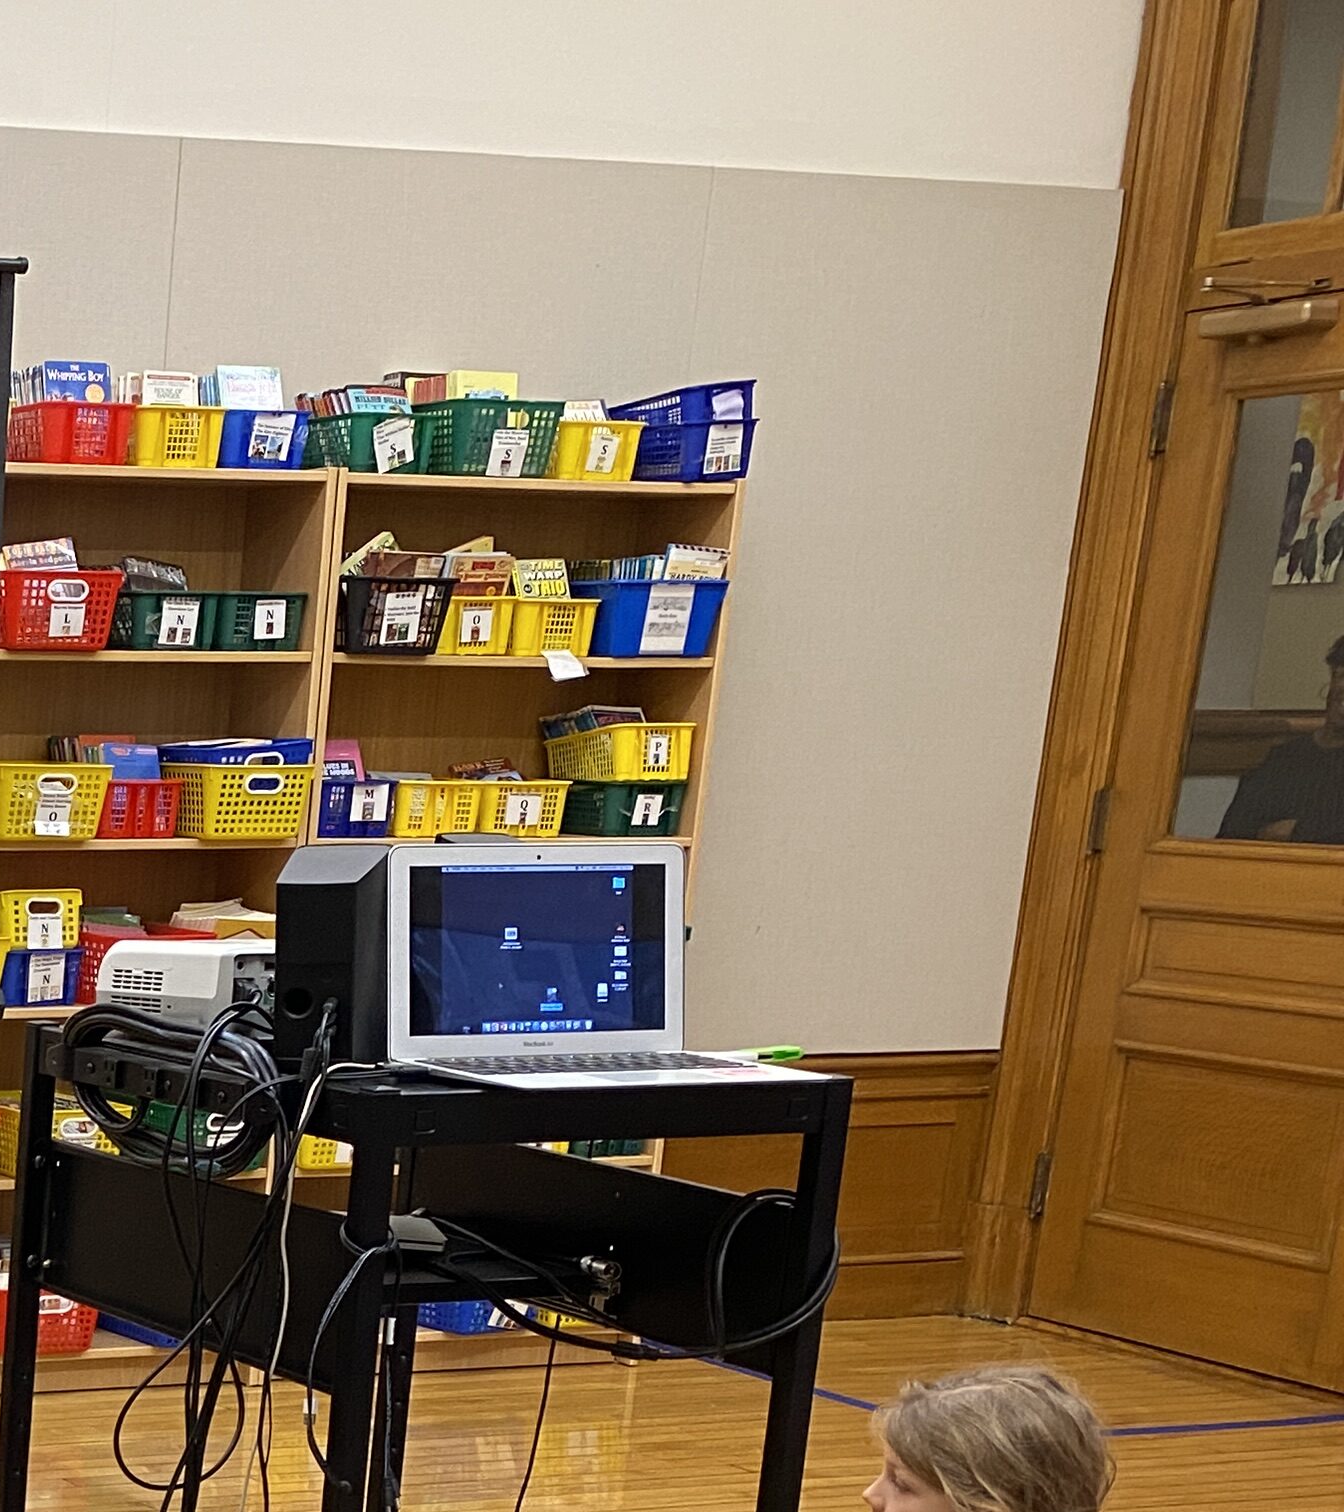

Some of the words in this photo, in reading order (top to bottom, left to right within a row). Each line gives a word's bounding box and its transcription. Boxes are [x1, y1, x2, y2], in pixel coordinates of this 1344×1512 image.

[47, 368, 87, 382] WHIPPING
[88, 370, 105, 382] BOY
[354, 395, 382, 403] MILLION
[384, 397, 407, 405] DOLLAR
[390, 443, 397, 454] S
[600, 444, 609, 455] S
[504, 449, 512, 460] S
[530, 561, 564, 571] TIME
[524, 570, 565, 581] WARP
[532, 580, 567, 597] TRIO
[64, 613, 71, 624] L
[176, 615, 185, 625] N
[266, 609, 275, 620] N
[655, 742, 662, 751] P
[364, 789, 374, 799] M
[520, 799, 529, 811] Q
[643, 803, 651, 812] R
[41, 923, 49, 934] N
[42, 975, 51, 985] N
